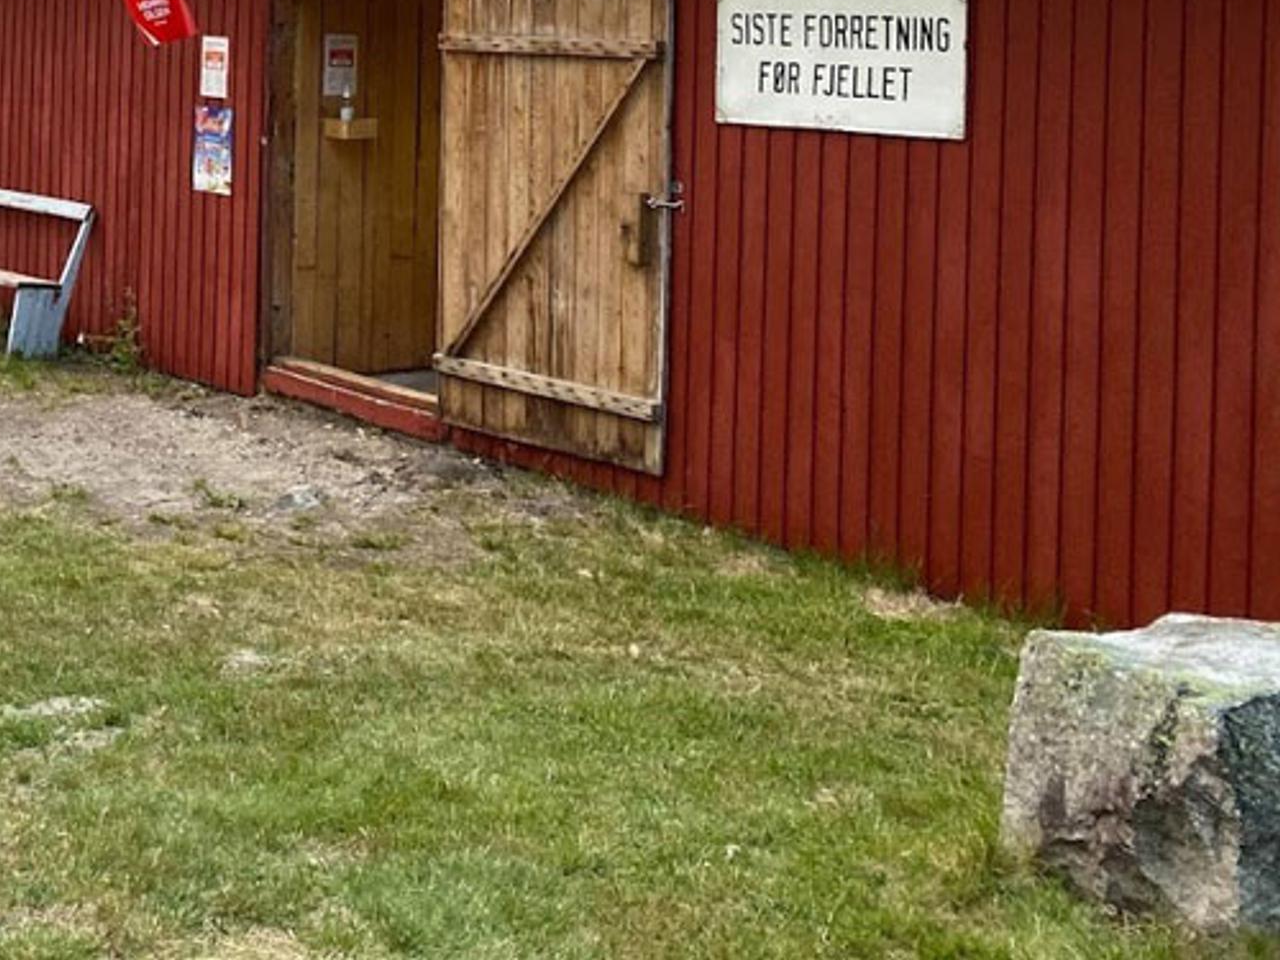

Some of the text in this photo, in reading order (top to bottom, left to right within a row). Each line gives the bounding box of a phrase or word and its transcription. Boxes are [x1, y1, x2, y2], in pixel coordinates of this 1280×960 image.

[730, 13, 950, 52] SISTE FORRETNING
[758, 61, 912, 102] FØR FJELLET
